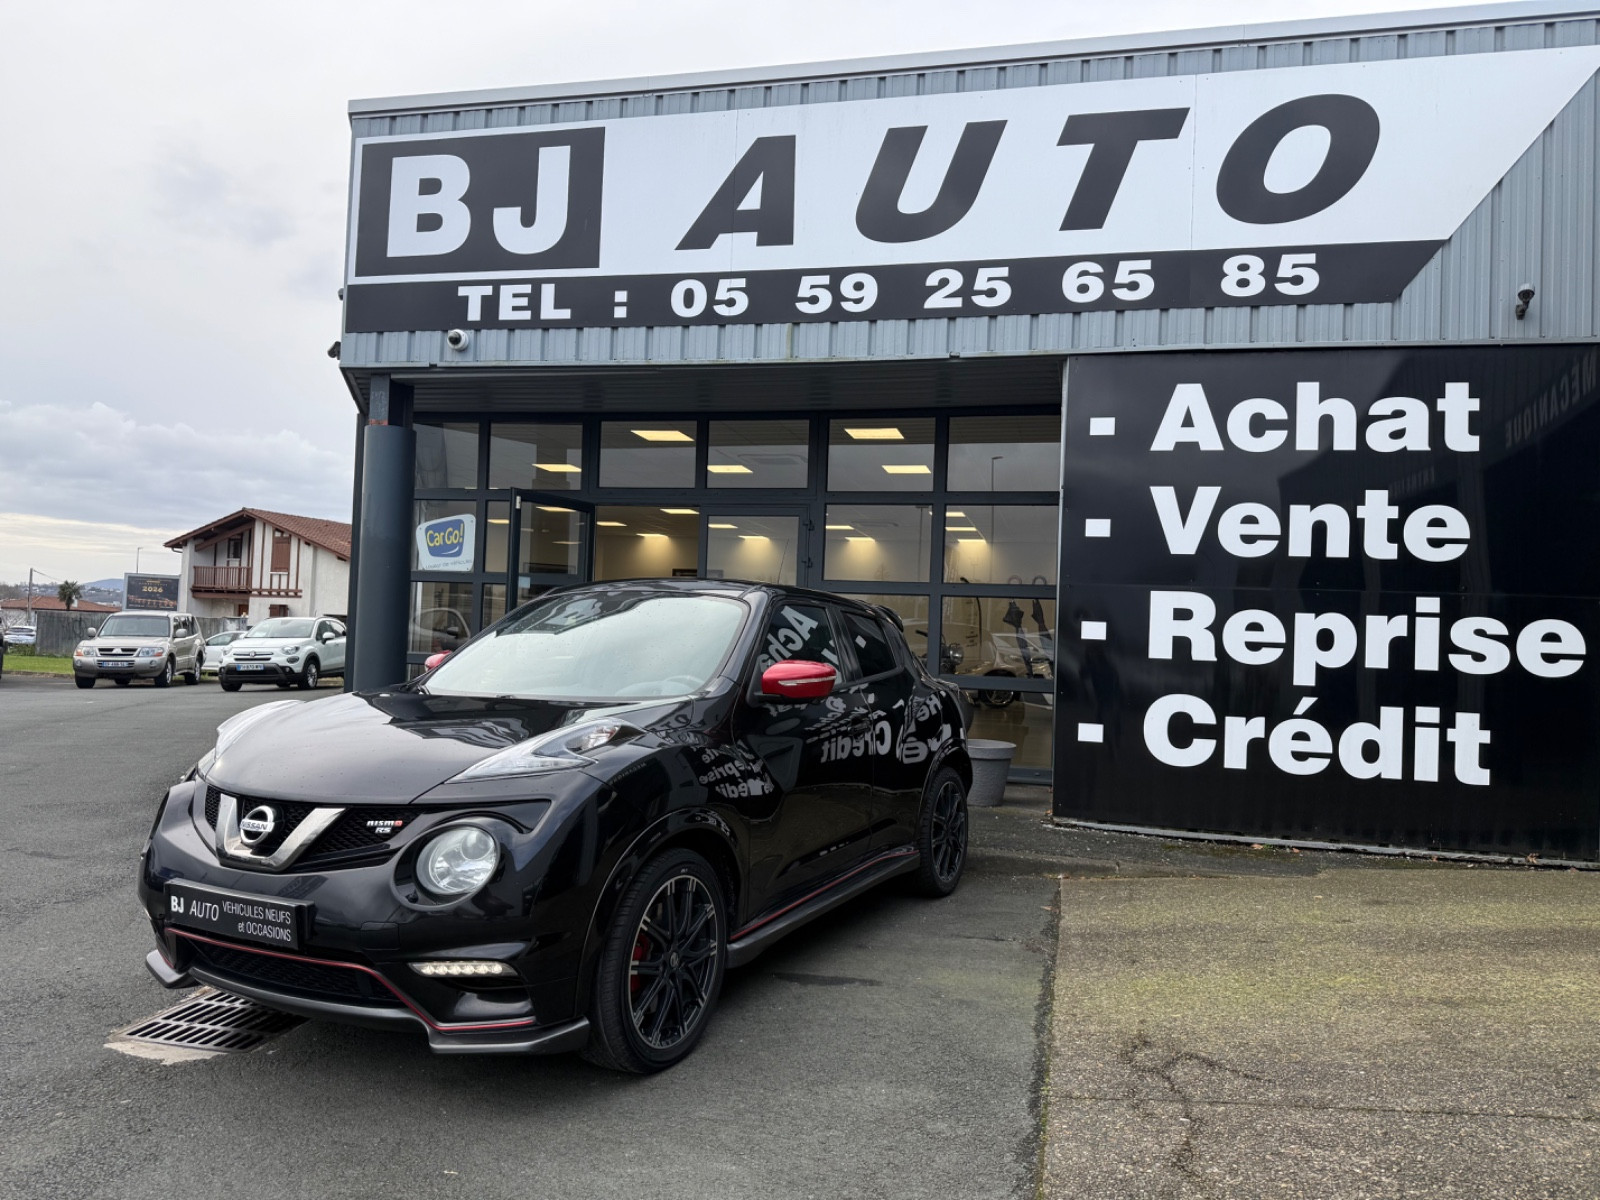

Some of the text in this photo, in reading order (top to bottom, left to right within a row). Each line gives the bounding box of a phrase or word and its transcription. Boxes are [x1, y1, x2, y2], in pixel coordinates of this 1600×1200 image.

[387, 93, 1381, 258] BJ AUTO
[457, 283, 572, 322] TEL
[670, 278, 749, 318] 05
[794, 272, 879, 314] 59
[915, 266, 1012, 310] 25
[1061, 259, 1155, 304] 65
[1220, 252, 1320, 297] 85
[1150, 380, 1480, 453] Achat
[1150, 485, 1471, 562] Vente
[1148, 590, 1586, 687] Reprise
[1143, 693, 1491, 786] Crédit
[241, 821, 268, 830] NISSAN
[170, 895, 291, 925] BJ AUTO VEHICULES NEUFS
[238, 921, 291, 942] et OCCASIONS
